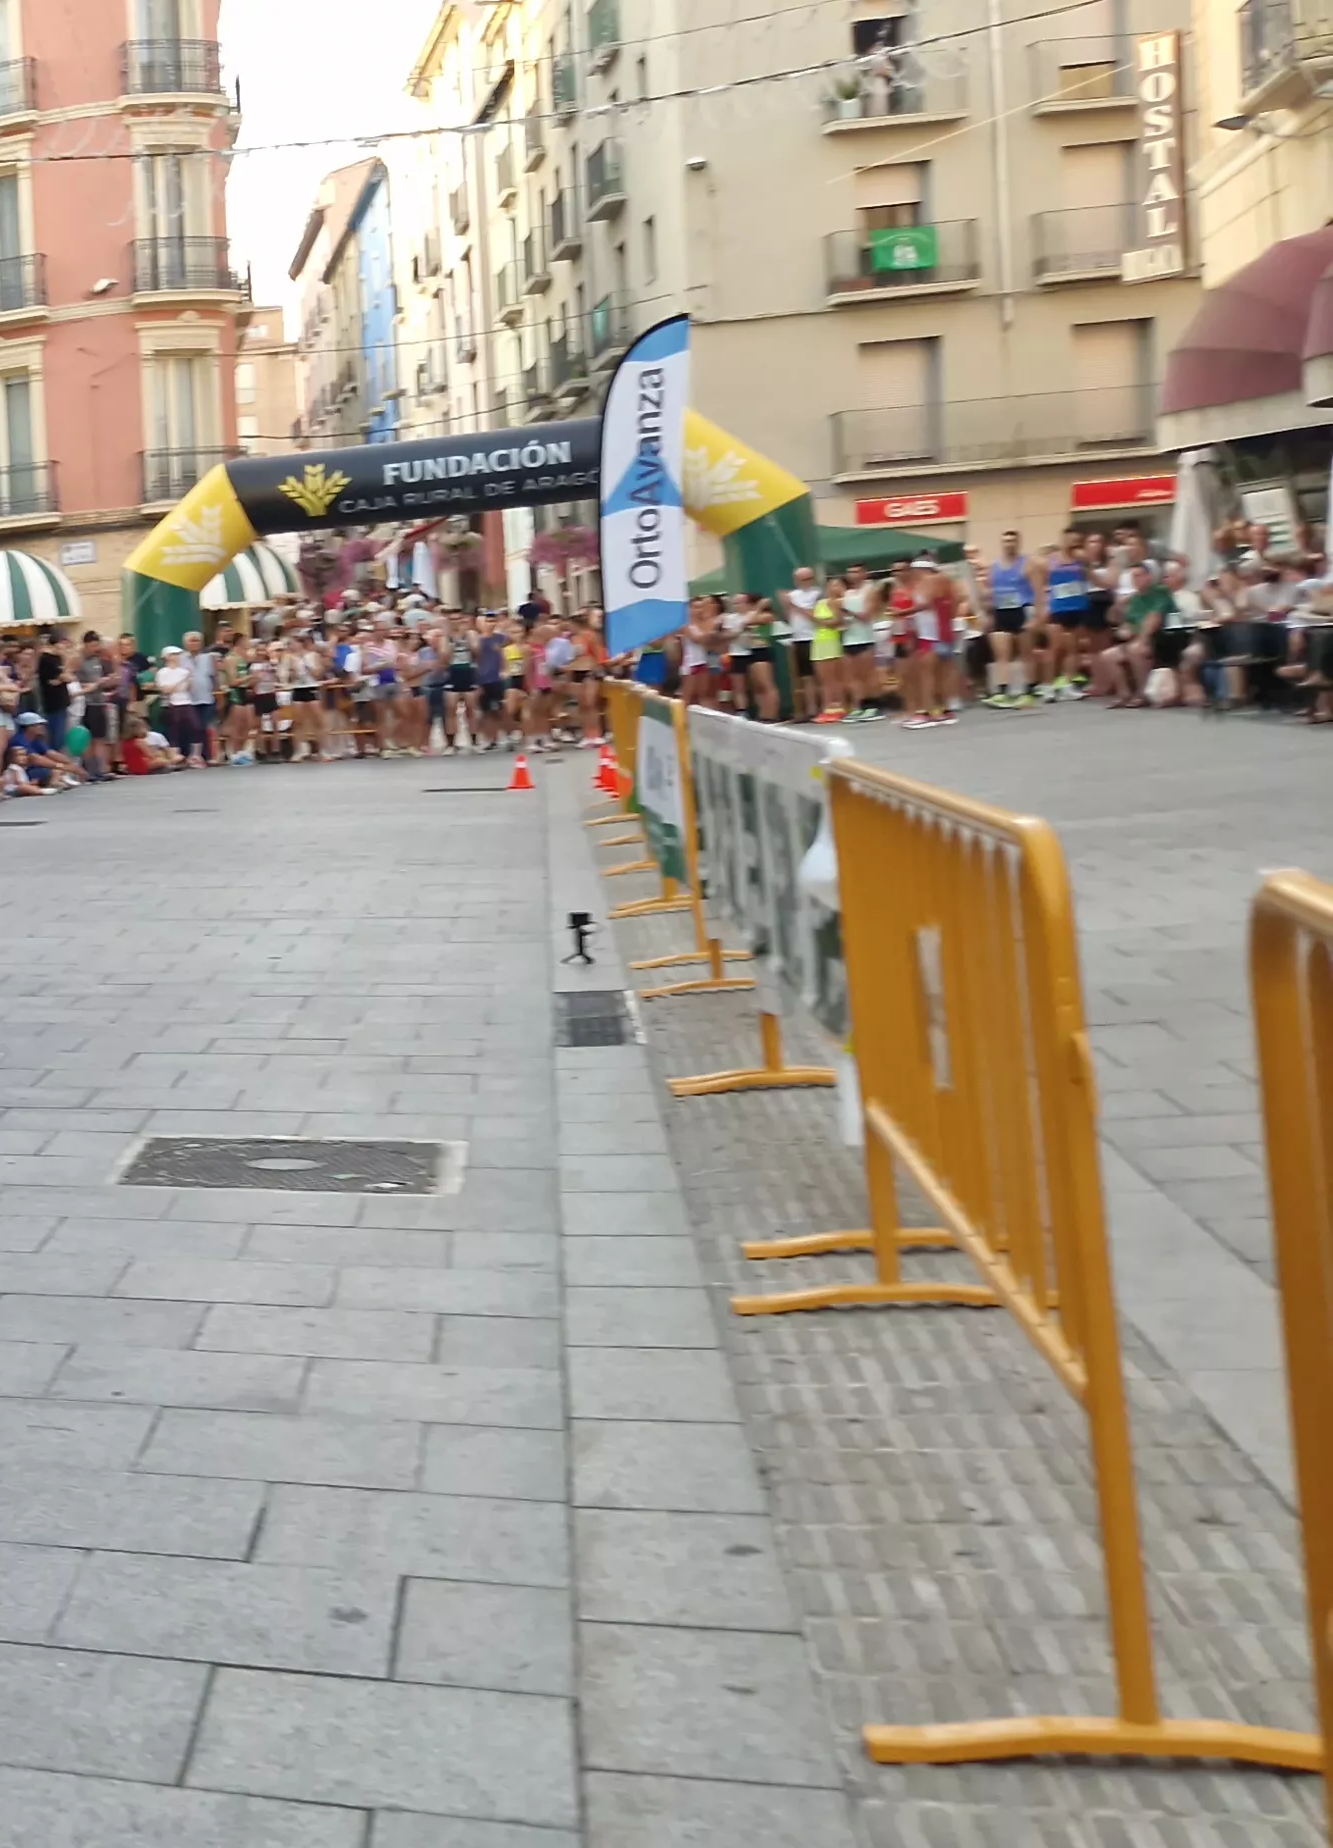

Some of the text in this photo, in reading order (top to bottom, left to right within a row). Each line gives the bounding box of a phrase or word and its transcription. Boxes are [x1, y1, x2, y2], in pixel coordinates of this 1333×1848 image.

[1137, 35, 1180, 239] HOSTAL
[382, 439, 572, 486] FUNDACIÓN
[627, 367, 665, 590] OrtoAvanza
[338, 495, 398, 514] CAJA
[402, 487, 479, 506] RURAL
[484, 480, 516, 497] DE
[884, 499, 941, 518] GAES
